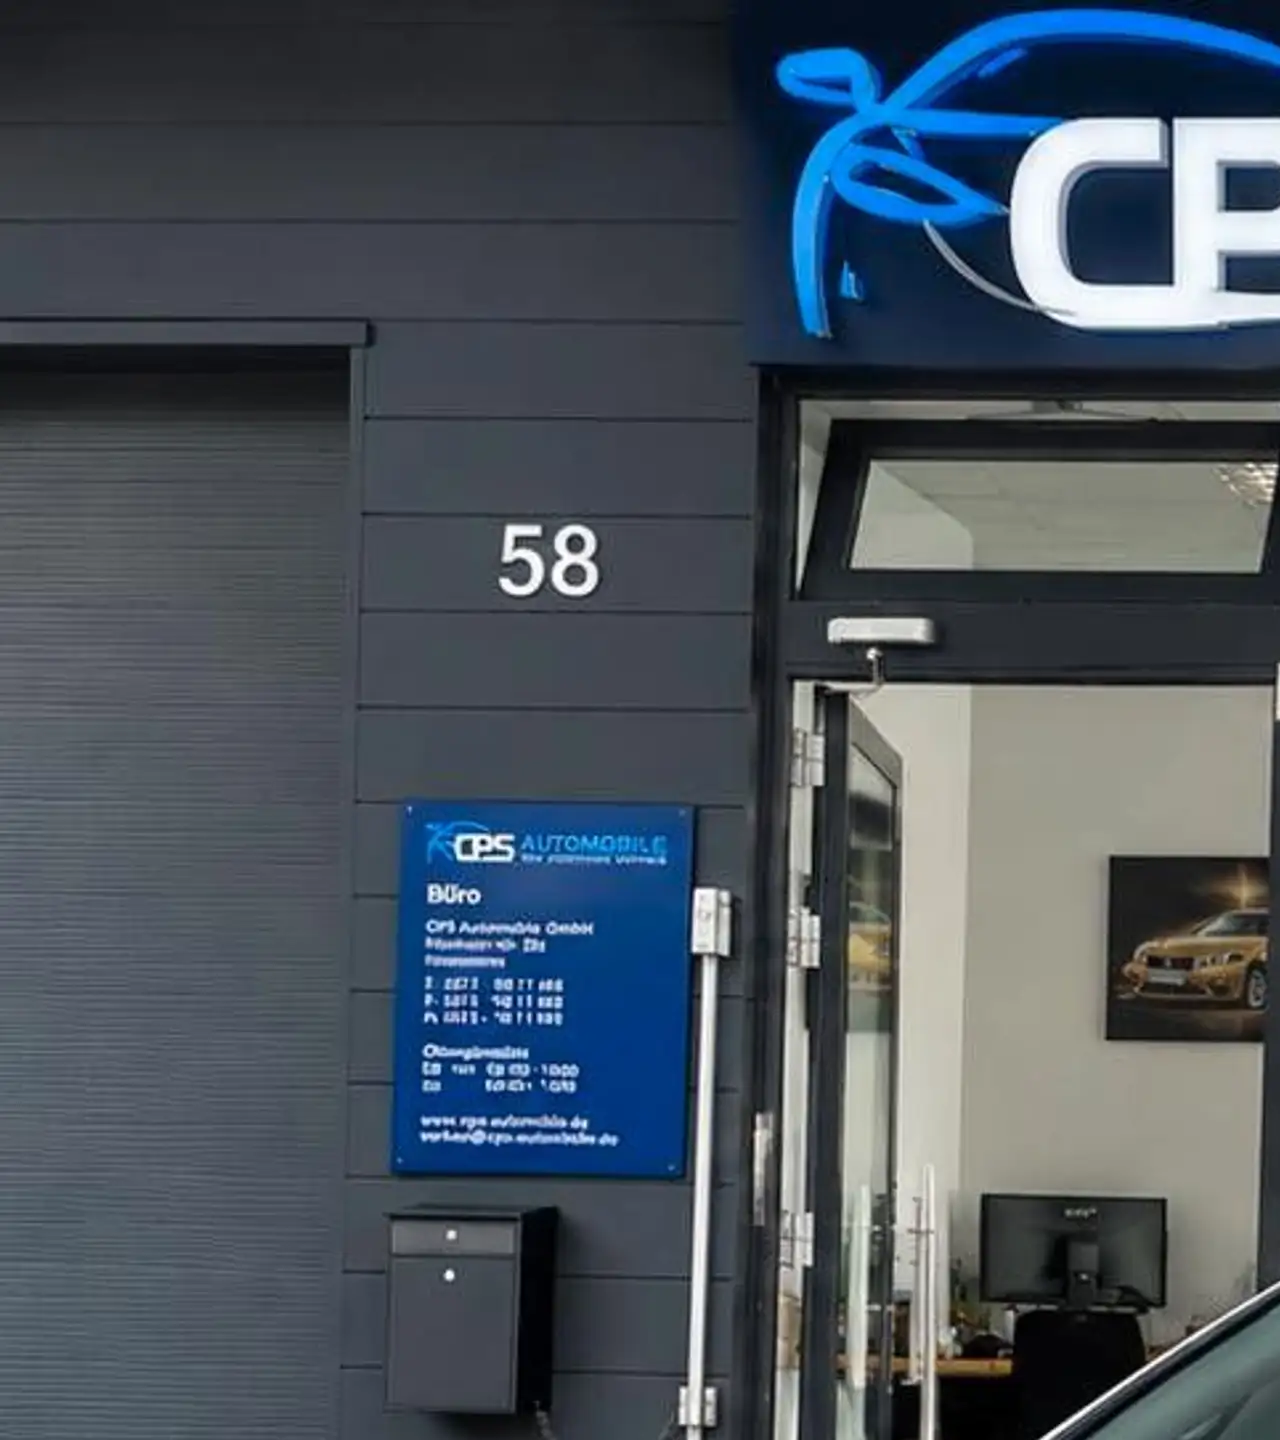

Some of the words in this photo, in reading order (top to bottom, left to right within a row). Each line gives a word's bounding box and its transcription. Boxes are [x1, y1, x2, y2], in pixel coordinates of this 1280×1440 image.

[498, 523, 600, 597] 58
[454, 833, 516, 863] CPS
[427, 883, 482, 905] Büro
